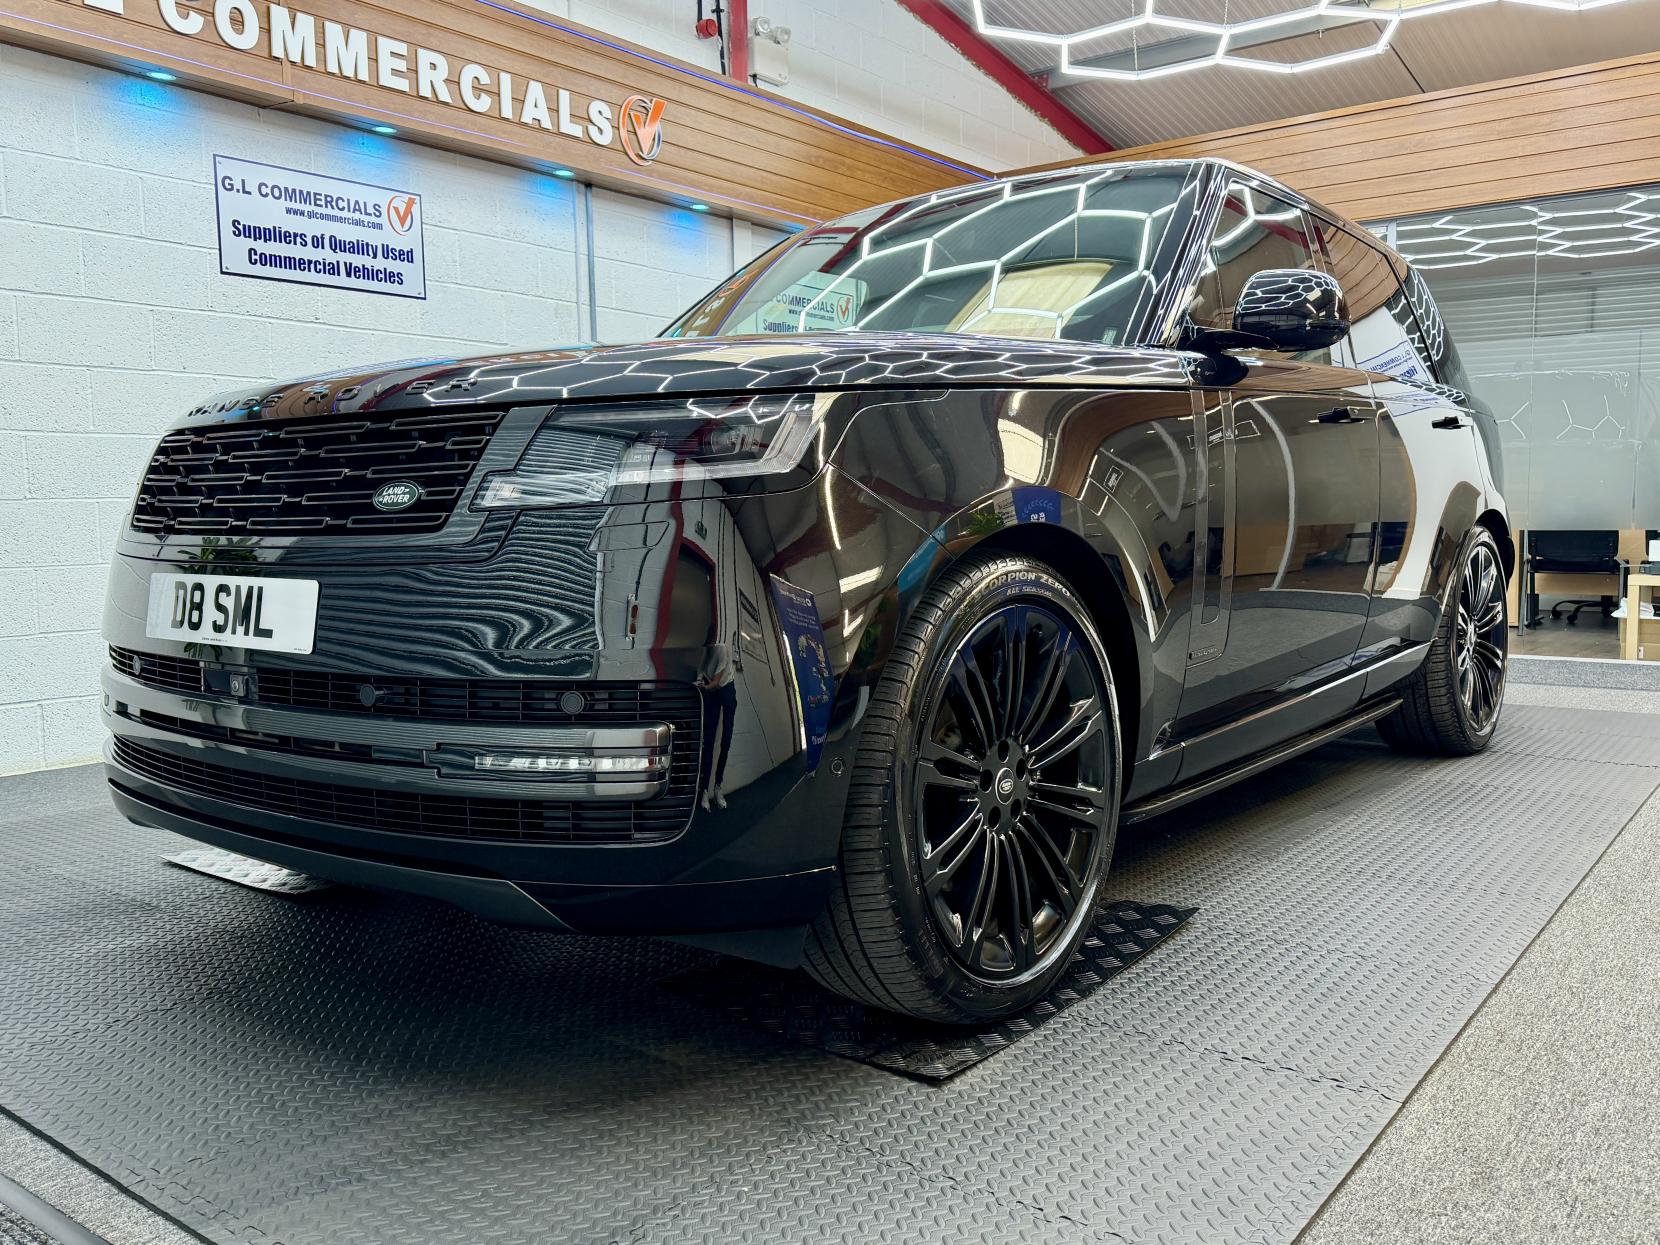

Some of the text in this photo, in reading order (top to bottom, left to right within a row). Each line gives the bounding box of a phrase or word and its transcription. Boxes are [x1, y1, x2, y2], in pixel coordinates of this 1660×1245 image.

[158, 0, 613, 146] COMMERCIALS
[221, 175, 383, 219] G.L COMMERCIALS
[285, 206, 383, 231] www.glcommercials.com
[231, 218, 414, 264] Suppliers of Quality Used
[247, 247, 404, 286] Commercial Vehicles
[382, 494, 410, 503] ROVER
[973, 571, 1070, 602] SCORPION ZERO
[170, 580, 274, 639] D8 SML
